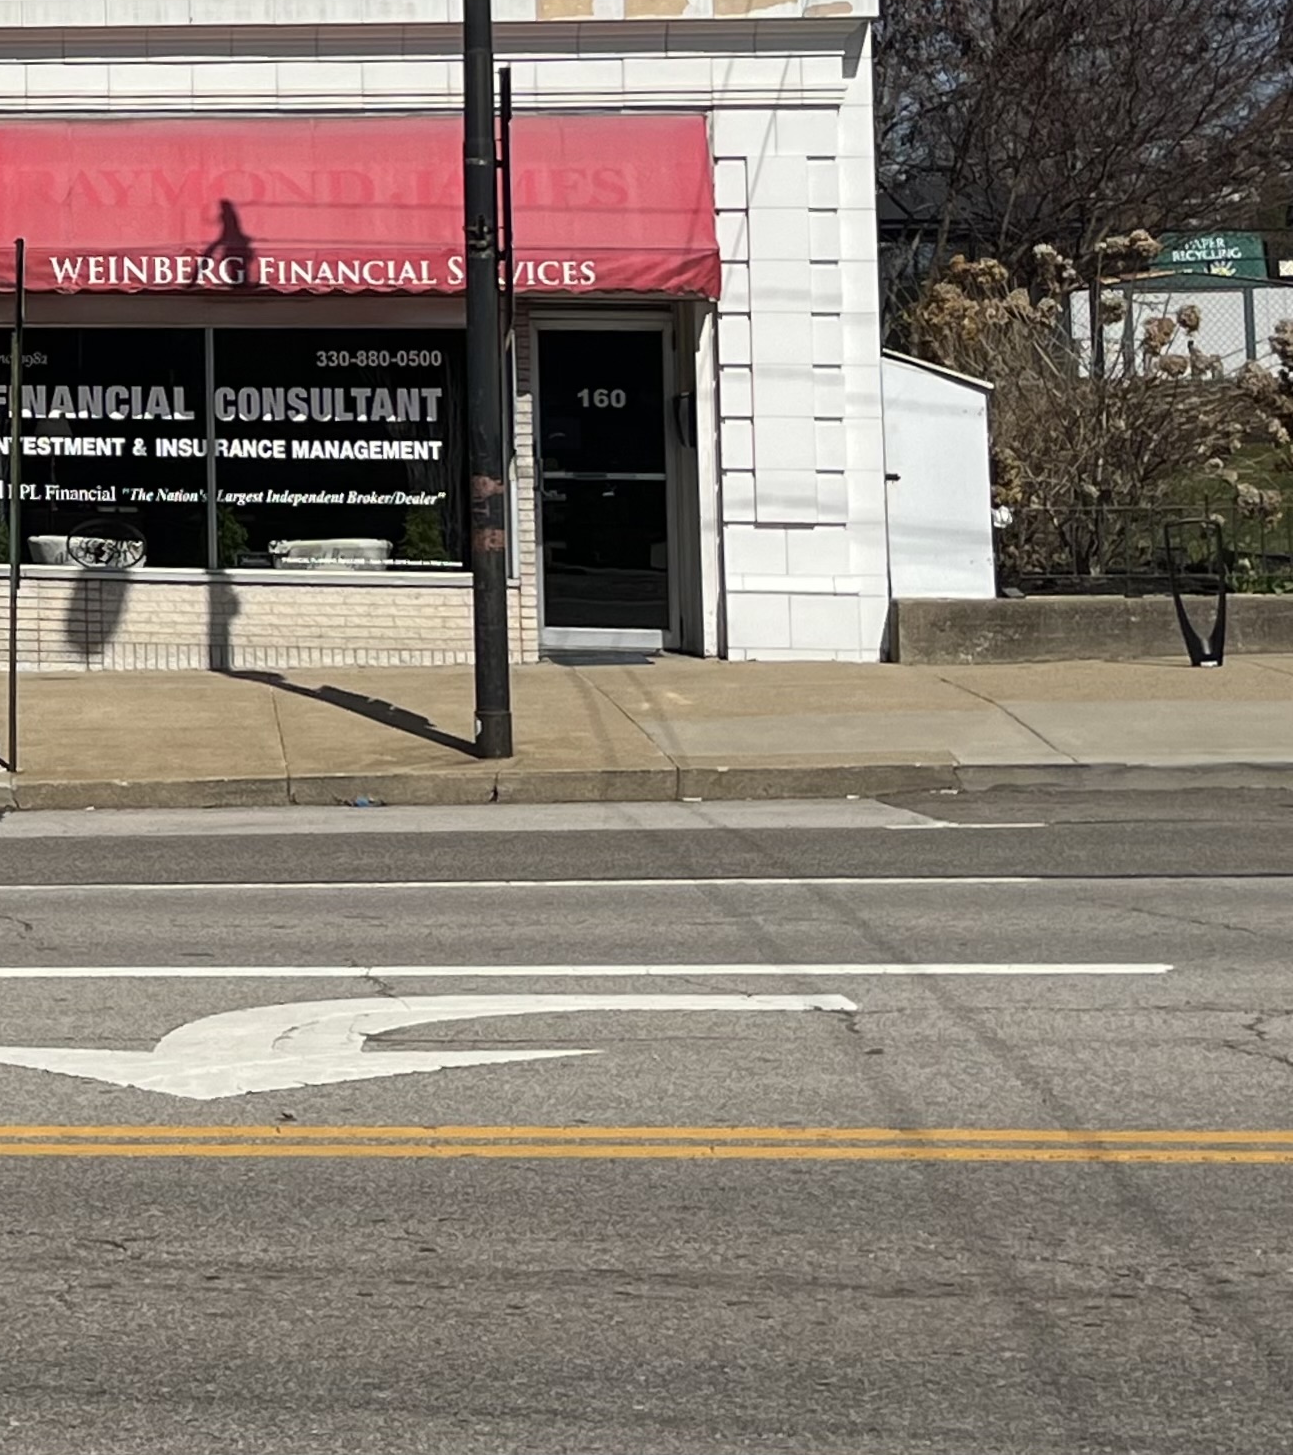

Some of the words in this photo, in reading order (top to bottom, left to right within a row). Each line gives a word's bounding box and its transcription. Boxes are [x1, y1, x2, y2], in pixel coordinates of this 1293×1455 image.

[49, 256, 246, 286] WEINBERG
[258, 256, 438, 286] FINANCIAL
[447, 256, 596, 287] SVICES
[316, 350, 442, 367] 330-880-0500
[214, 387, 443, 422] CONSULTANT
[577, 388, 626, 408] 160
[132, 438, 147, 456] &
[155, 438, 286, 459] INSURANCE
[292, 440, 443, 460] MANAGEMENT
[45, 485, 116, 502] Financial
[216, 490, 264, 506] Largest
[266, 490, 344, 507] Independent
